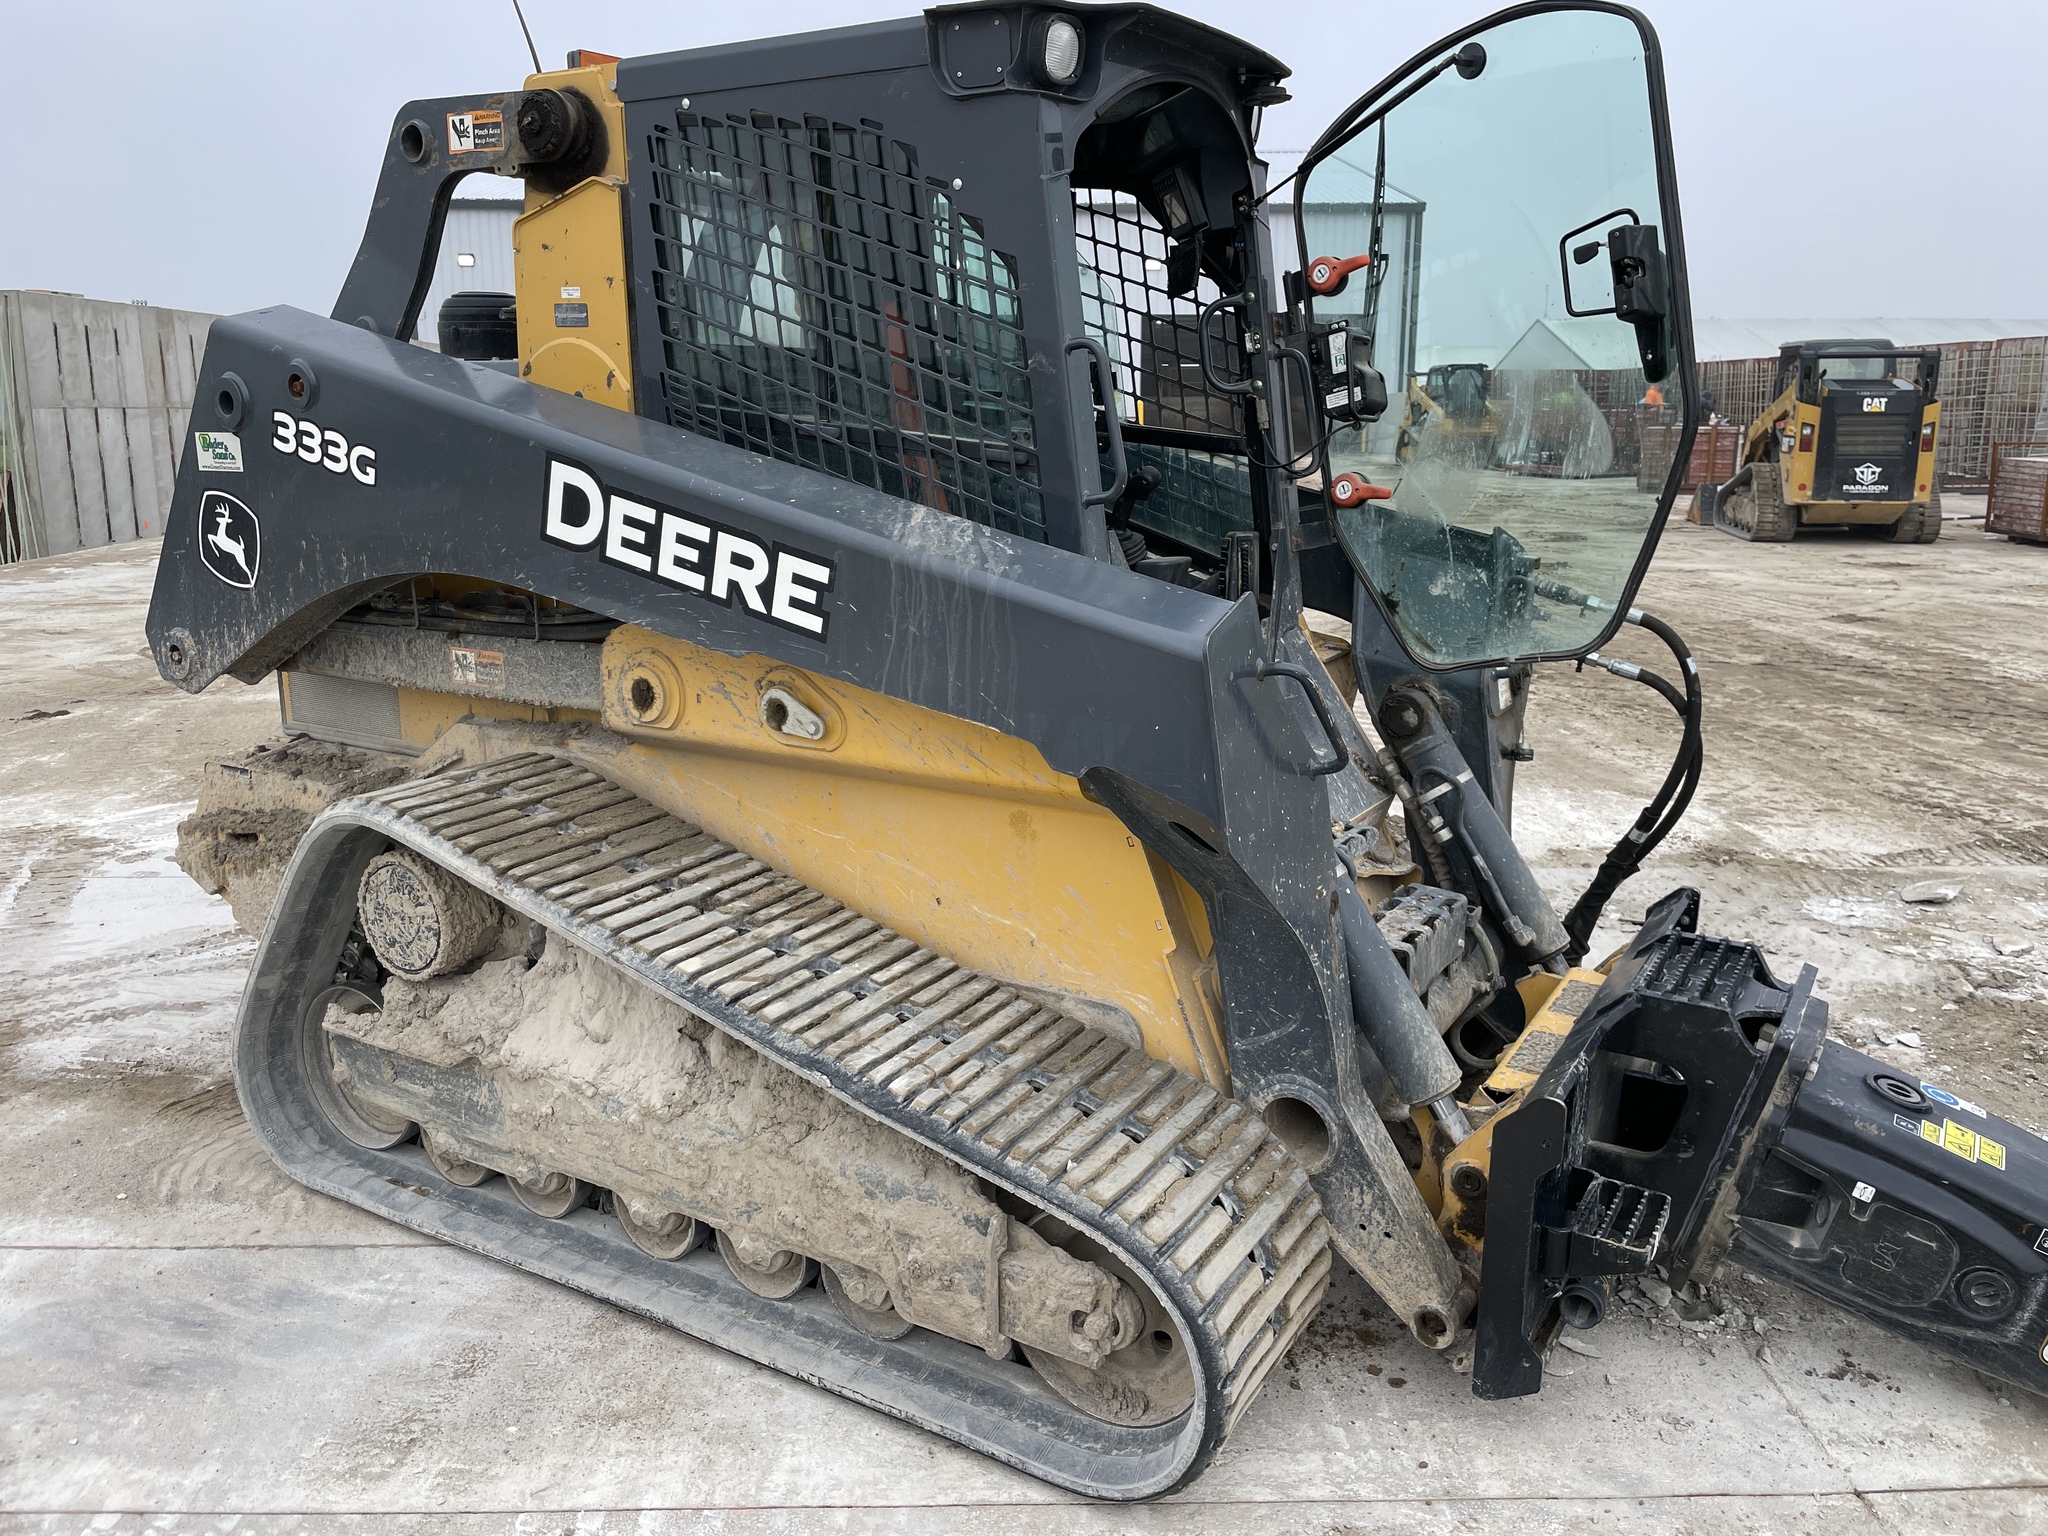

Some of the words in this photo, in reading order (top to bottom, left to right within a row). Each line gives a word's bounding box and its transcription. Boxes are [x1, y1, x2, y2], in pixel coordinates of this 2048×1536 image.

[474, 128, 488, 136] Pinch
[1862, 397, 1889, 412] CAT
[272, 410, 377, 486] 333G
[545, 459, 831, 635] DEERE
